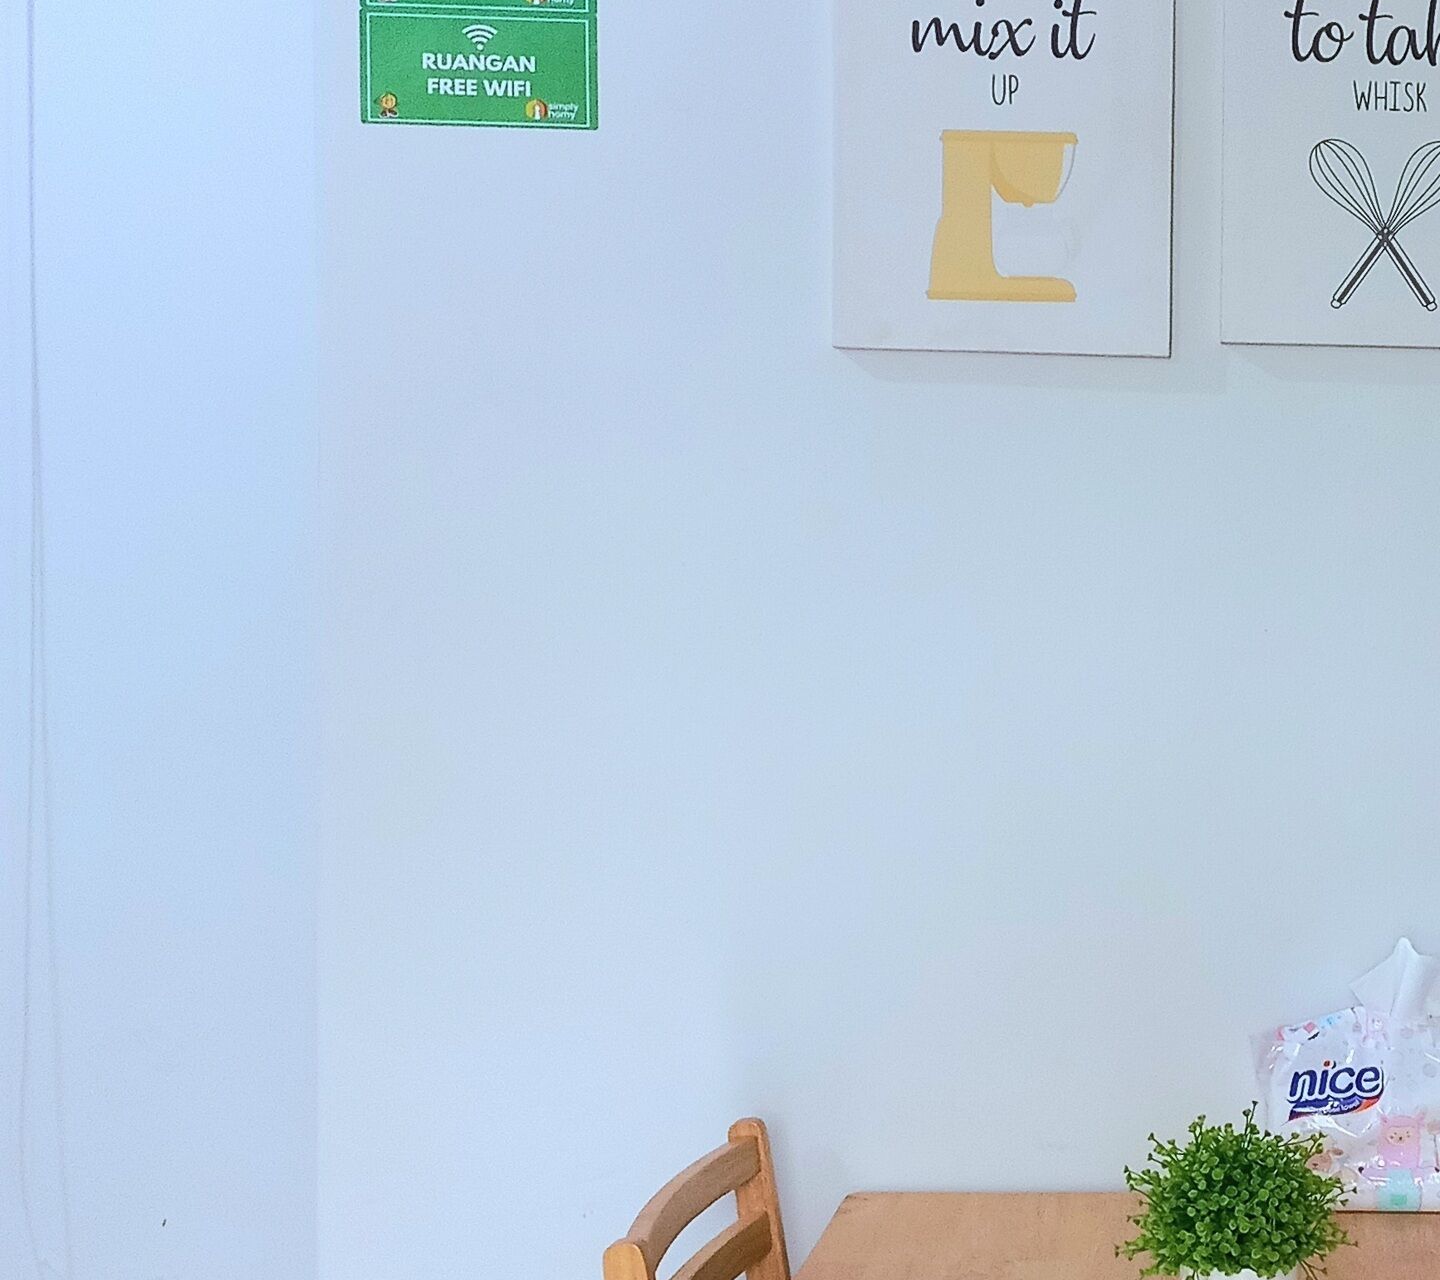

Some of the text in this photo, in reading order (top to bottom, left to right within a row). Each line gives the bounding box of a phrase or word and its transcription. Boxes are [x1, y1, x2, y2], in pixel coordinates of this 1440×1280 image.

[422, 53, 536, 73] RUANGAN
[427, 77, 532, 97] FREE WIFI
[991, 74, 1020, 106] UP
[1353, 81, 1428, 113] WHISK
[1289, 1060, 1380, 1097] nice
